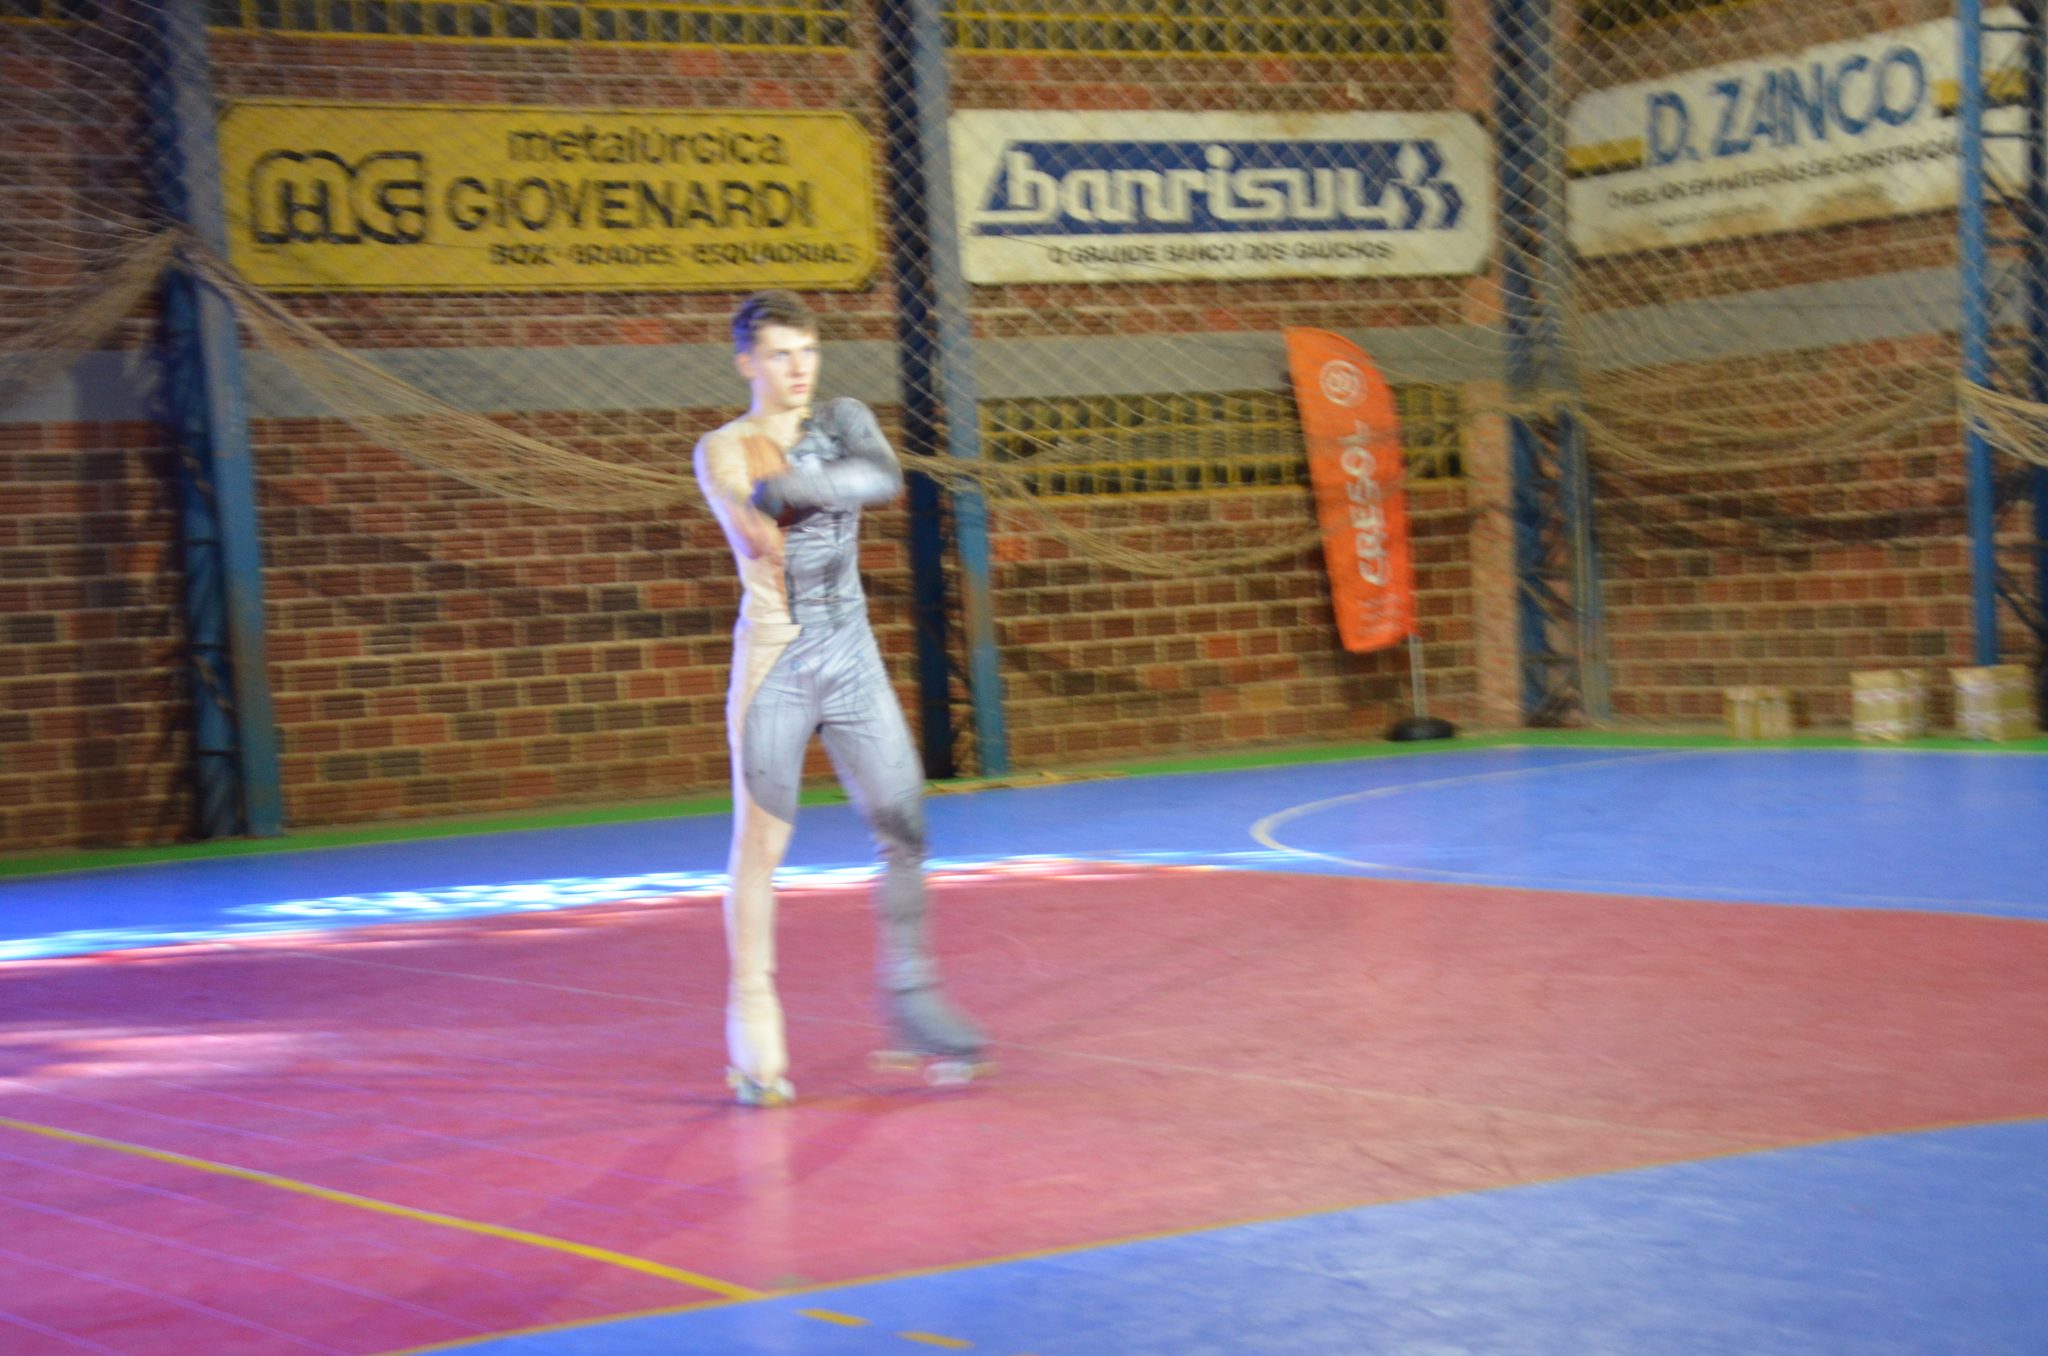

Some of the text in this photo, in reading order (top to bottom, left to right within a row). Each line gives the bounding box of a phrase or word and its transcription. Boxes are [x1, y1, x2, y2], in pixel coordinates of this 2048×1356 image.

[1709, 46, 1926, 157] ZANCO
[445, 176, 817, 232] GIOVENARDI
[973, 144, 1392, 224] banrisul
